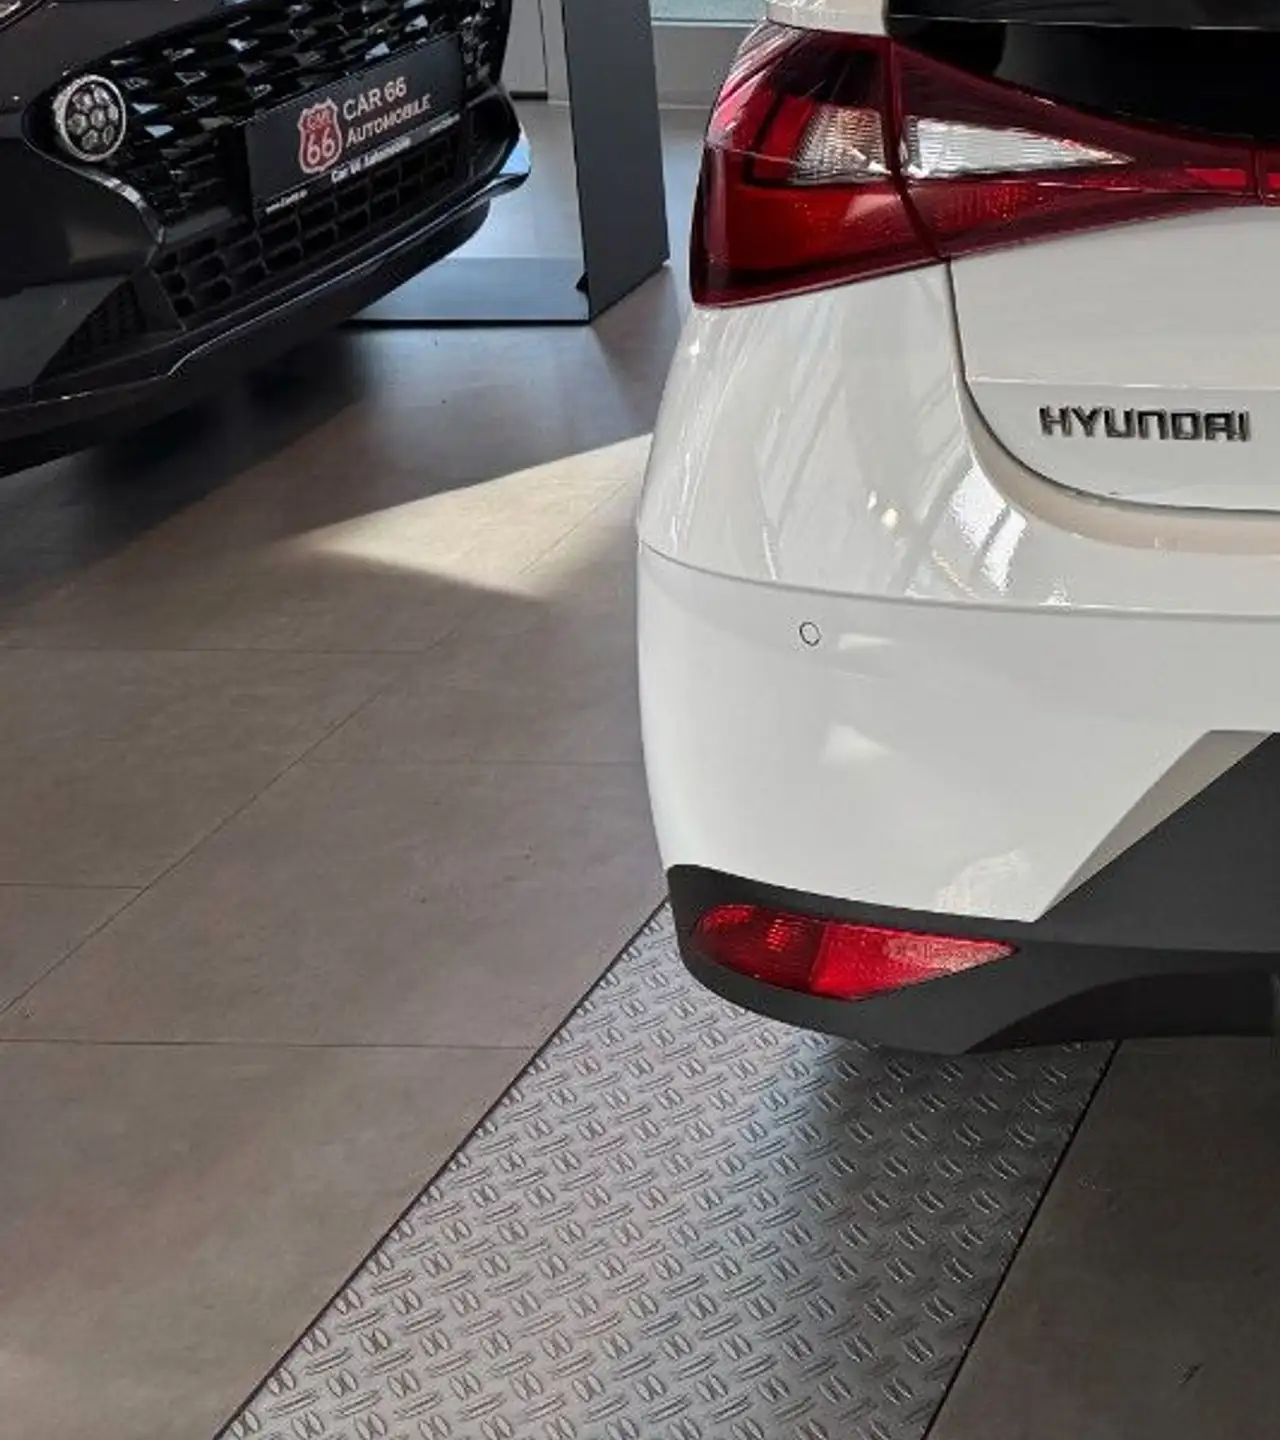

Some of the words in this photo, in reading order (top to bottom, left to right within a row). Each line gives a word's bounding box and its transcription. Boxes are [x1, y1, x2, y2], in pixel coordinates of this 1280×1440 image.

[343, 87, 382, 121] CAR
[384, 76, 407, 103] 66
[307, 128, 336, 165] 66
[1038, 406, 1250, 442] HYUNDAI
